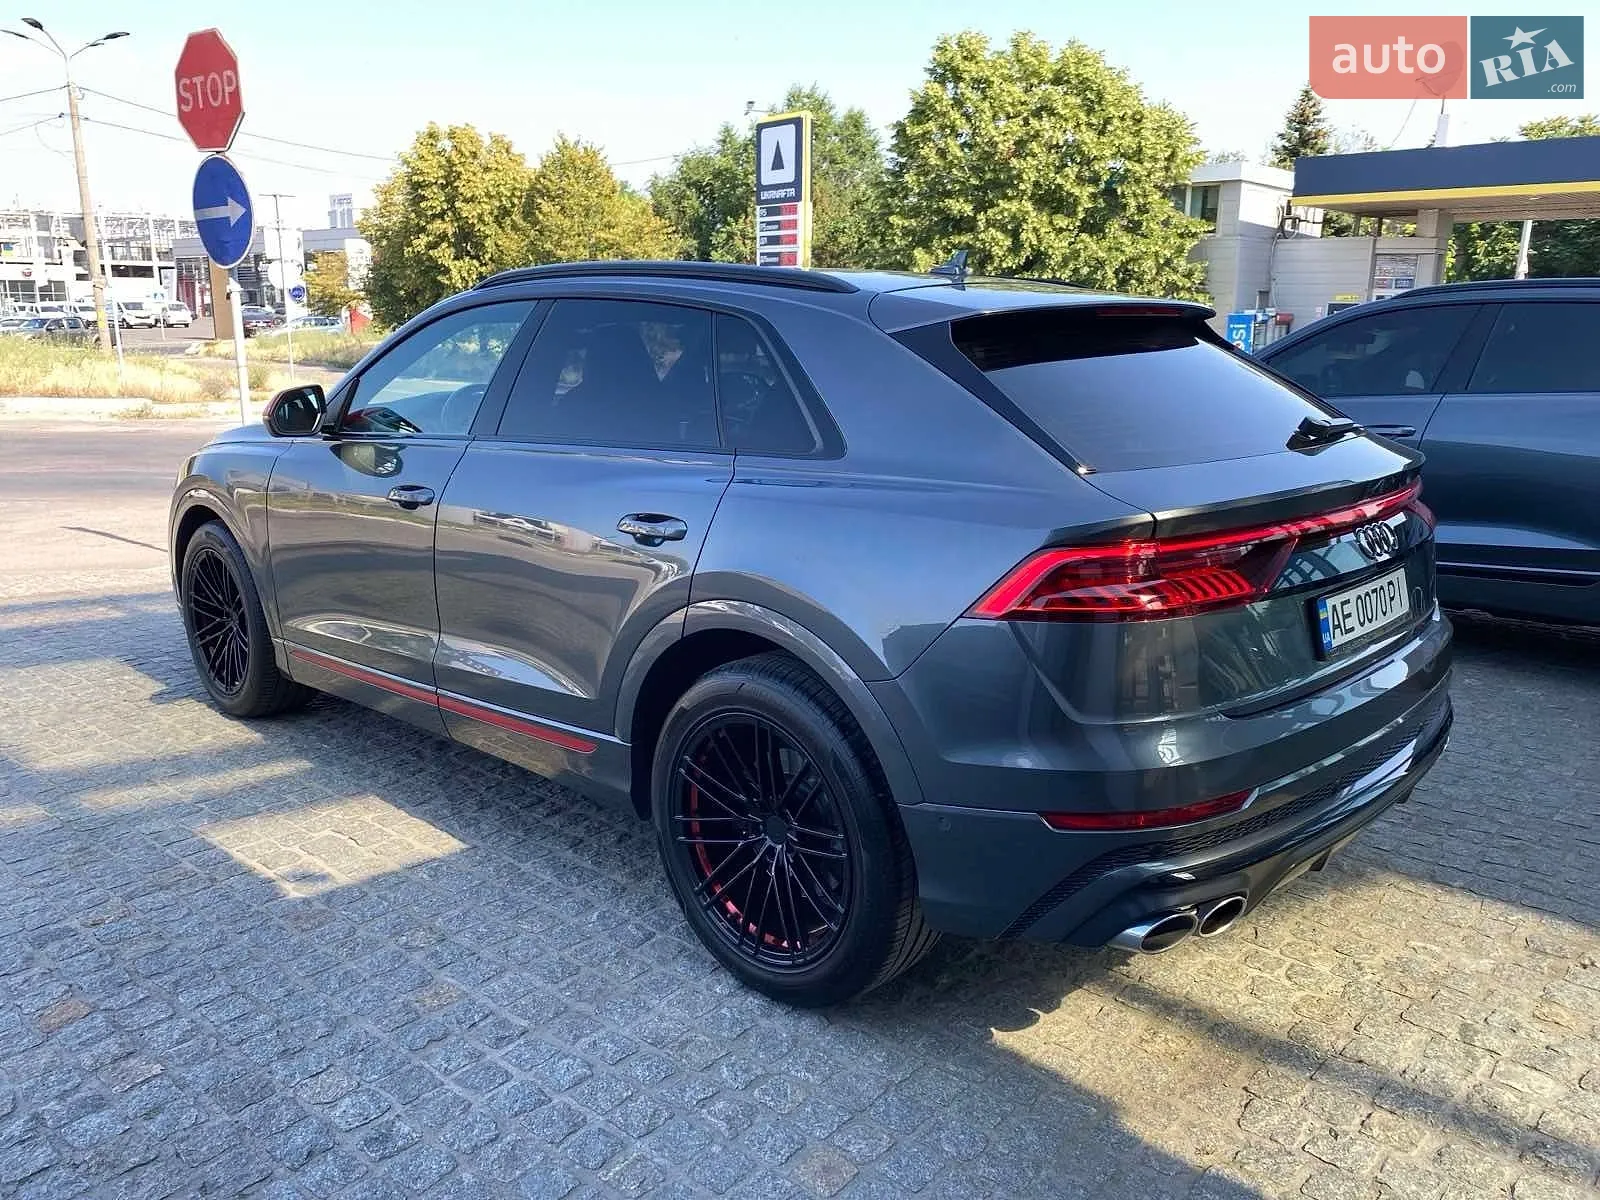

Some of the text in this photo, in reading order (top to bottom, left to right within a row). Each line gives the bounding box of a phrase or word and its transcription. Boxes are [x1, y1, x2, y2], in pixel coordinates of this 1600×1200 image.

[178, 69, 237, 113] STOP
[1331, 599, 1355, 640] AE
[1356, 585, 1388, 628] 0070
